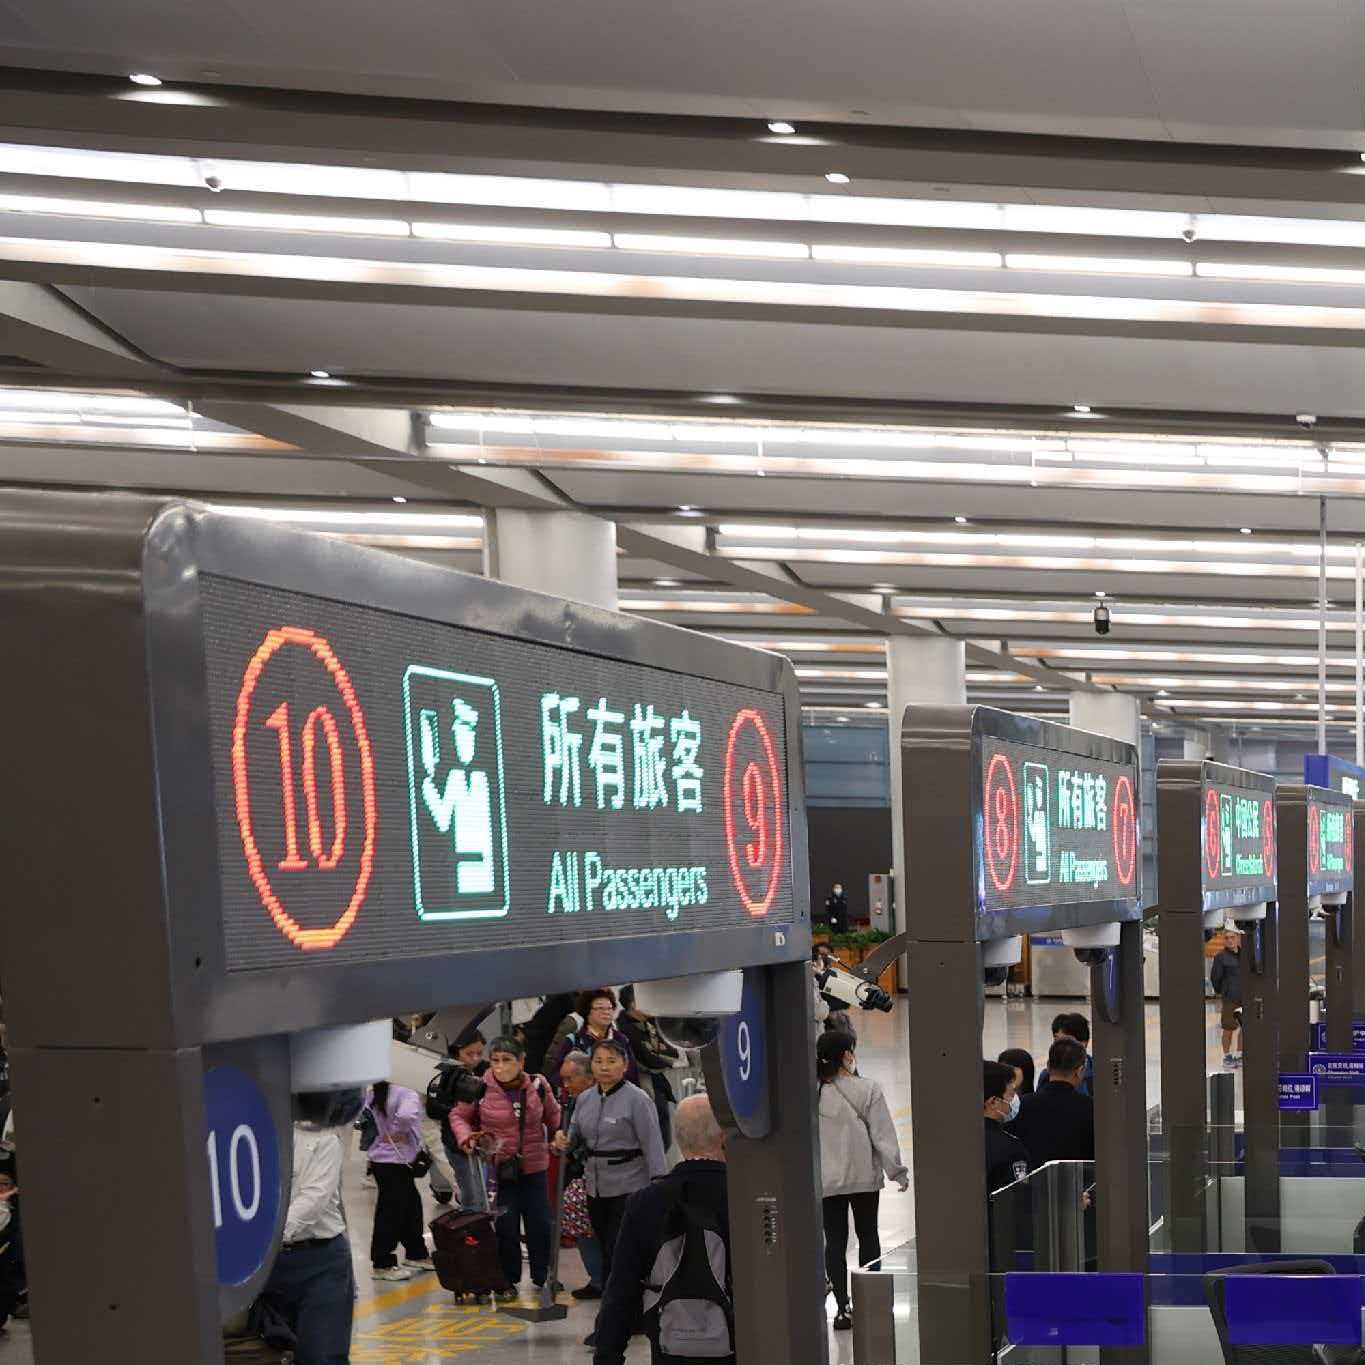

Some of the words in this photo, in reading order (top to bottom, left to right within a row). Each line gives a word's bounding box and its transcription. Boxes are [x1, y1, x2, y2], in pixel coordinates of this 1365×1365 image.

[266, 702, 348, 871] 10
[541, 691, 704, 813] 所有旅客
[547, 852, 580, 914] All
[584, 852, 708, 921] Passengers
[738, 1021, 751, 1081] 9
[207, 1124, 260, 1228] 10
